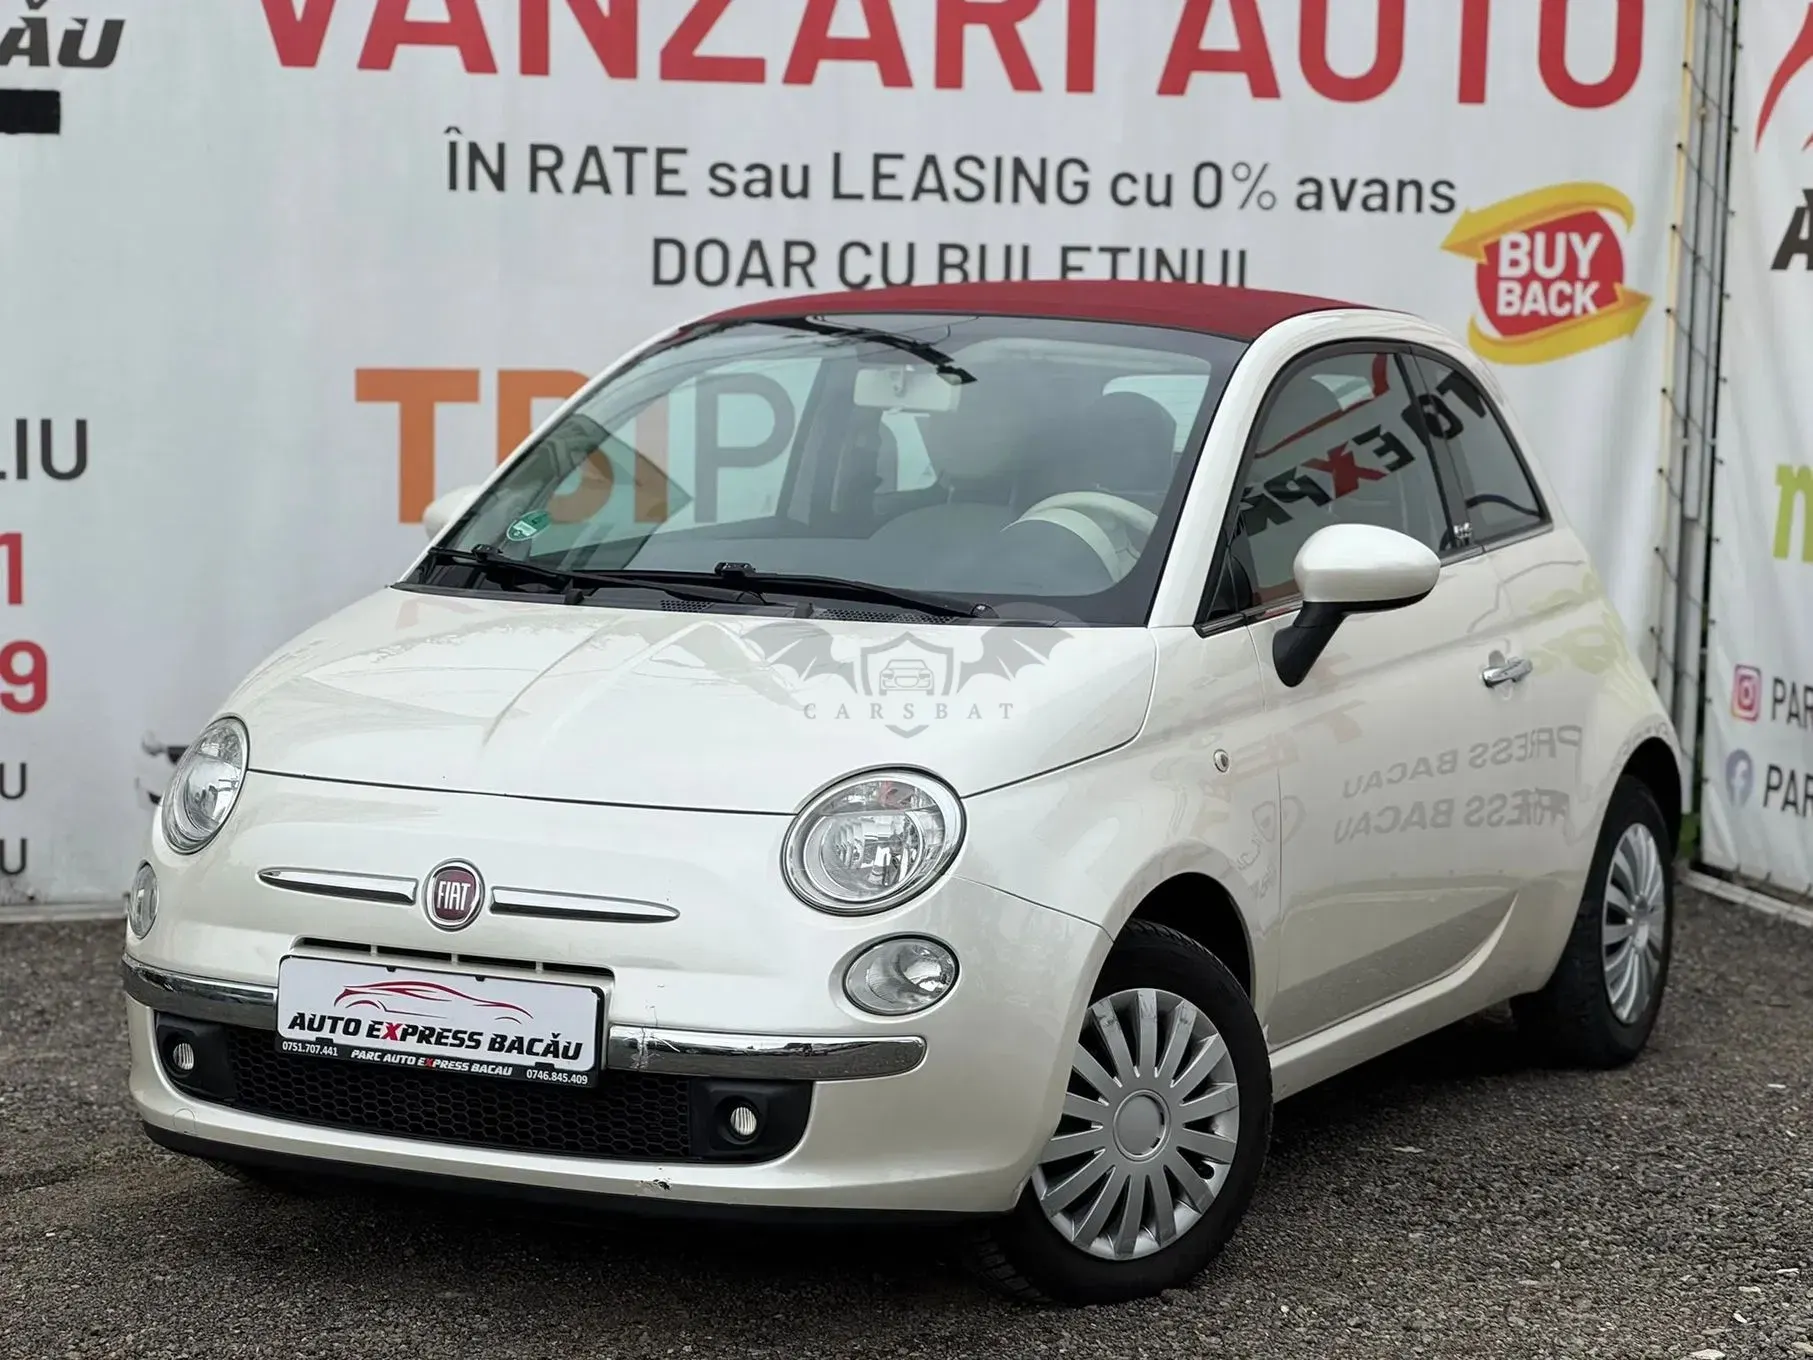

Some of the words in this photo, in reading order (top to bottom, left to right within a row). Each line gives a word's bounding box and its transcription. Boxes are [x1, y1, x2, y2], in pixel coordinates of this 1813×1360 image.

[443, 126, 506, 192] ÎN
[528, 143, 688, 197] RATE
[707, 160, 810, 200] sau
[831, 152, 1090, 207] LEASING
[1109, 170, 1173, 209] cu
[1192, 161, 1277, 211] 0%
[1295, 176, 1458, 215] avans
[651, 237, 818, 288] DOAR
[837, 241, 916, 289] CU
[1498, 230, 1603, 280] BUY
[1496, 279, 1601, 318] BACK
[437, 880, 472, 911] FIAT
[282, 1040, 339, 1057] 0751.707.441
[288, 1011, 362, 1037] AUTO
[366, 1019, 484, 1050] EXPRESS
[487, 1032, 584, 1061] BACĂU
[350, 1049, 381, 1062] PARC
[383, 1053, 416, 1066] AUTO
[417, 1057, 470, 1071] EXPRESS
[471, 1063, 513, 1077] BACAU
[526, 1068, 588, 1085] 0746.845.409
